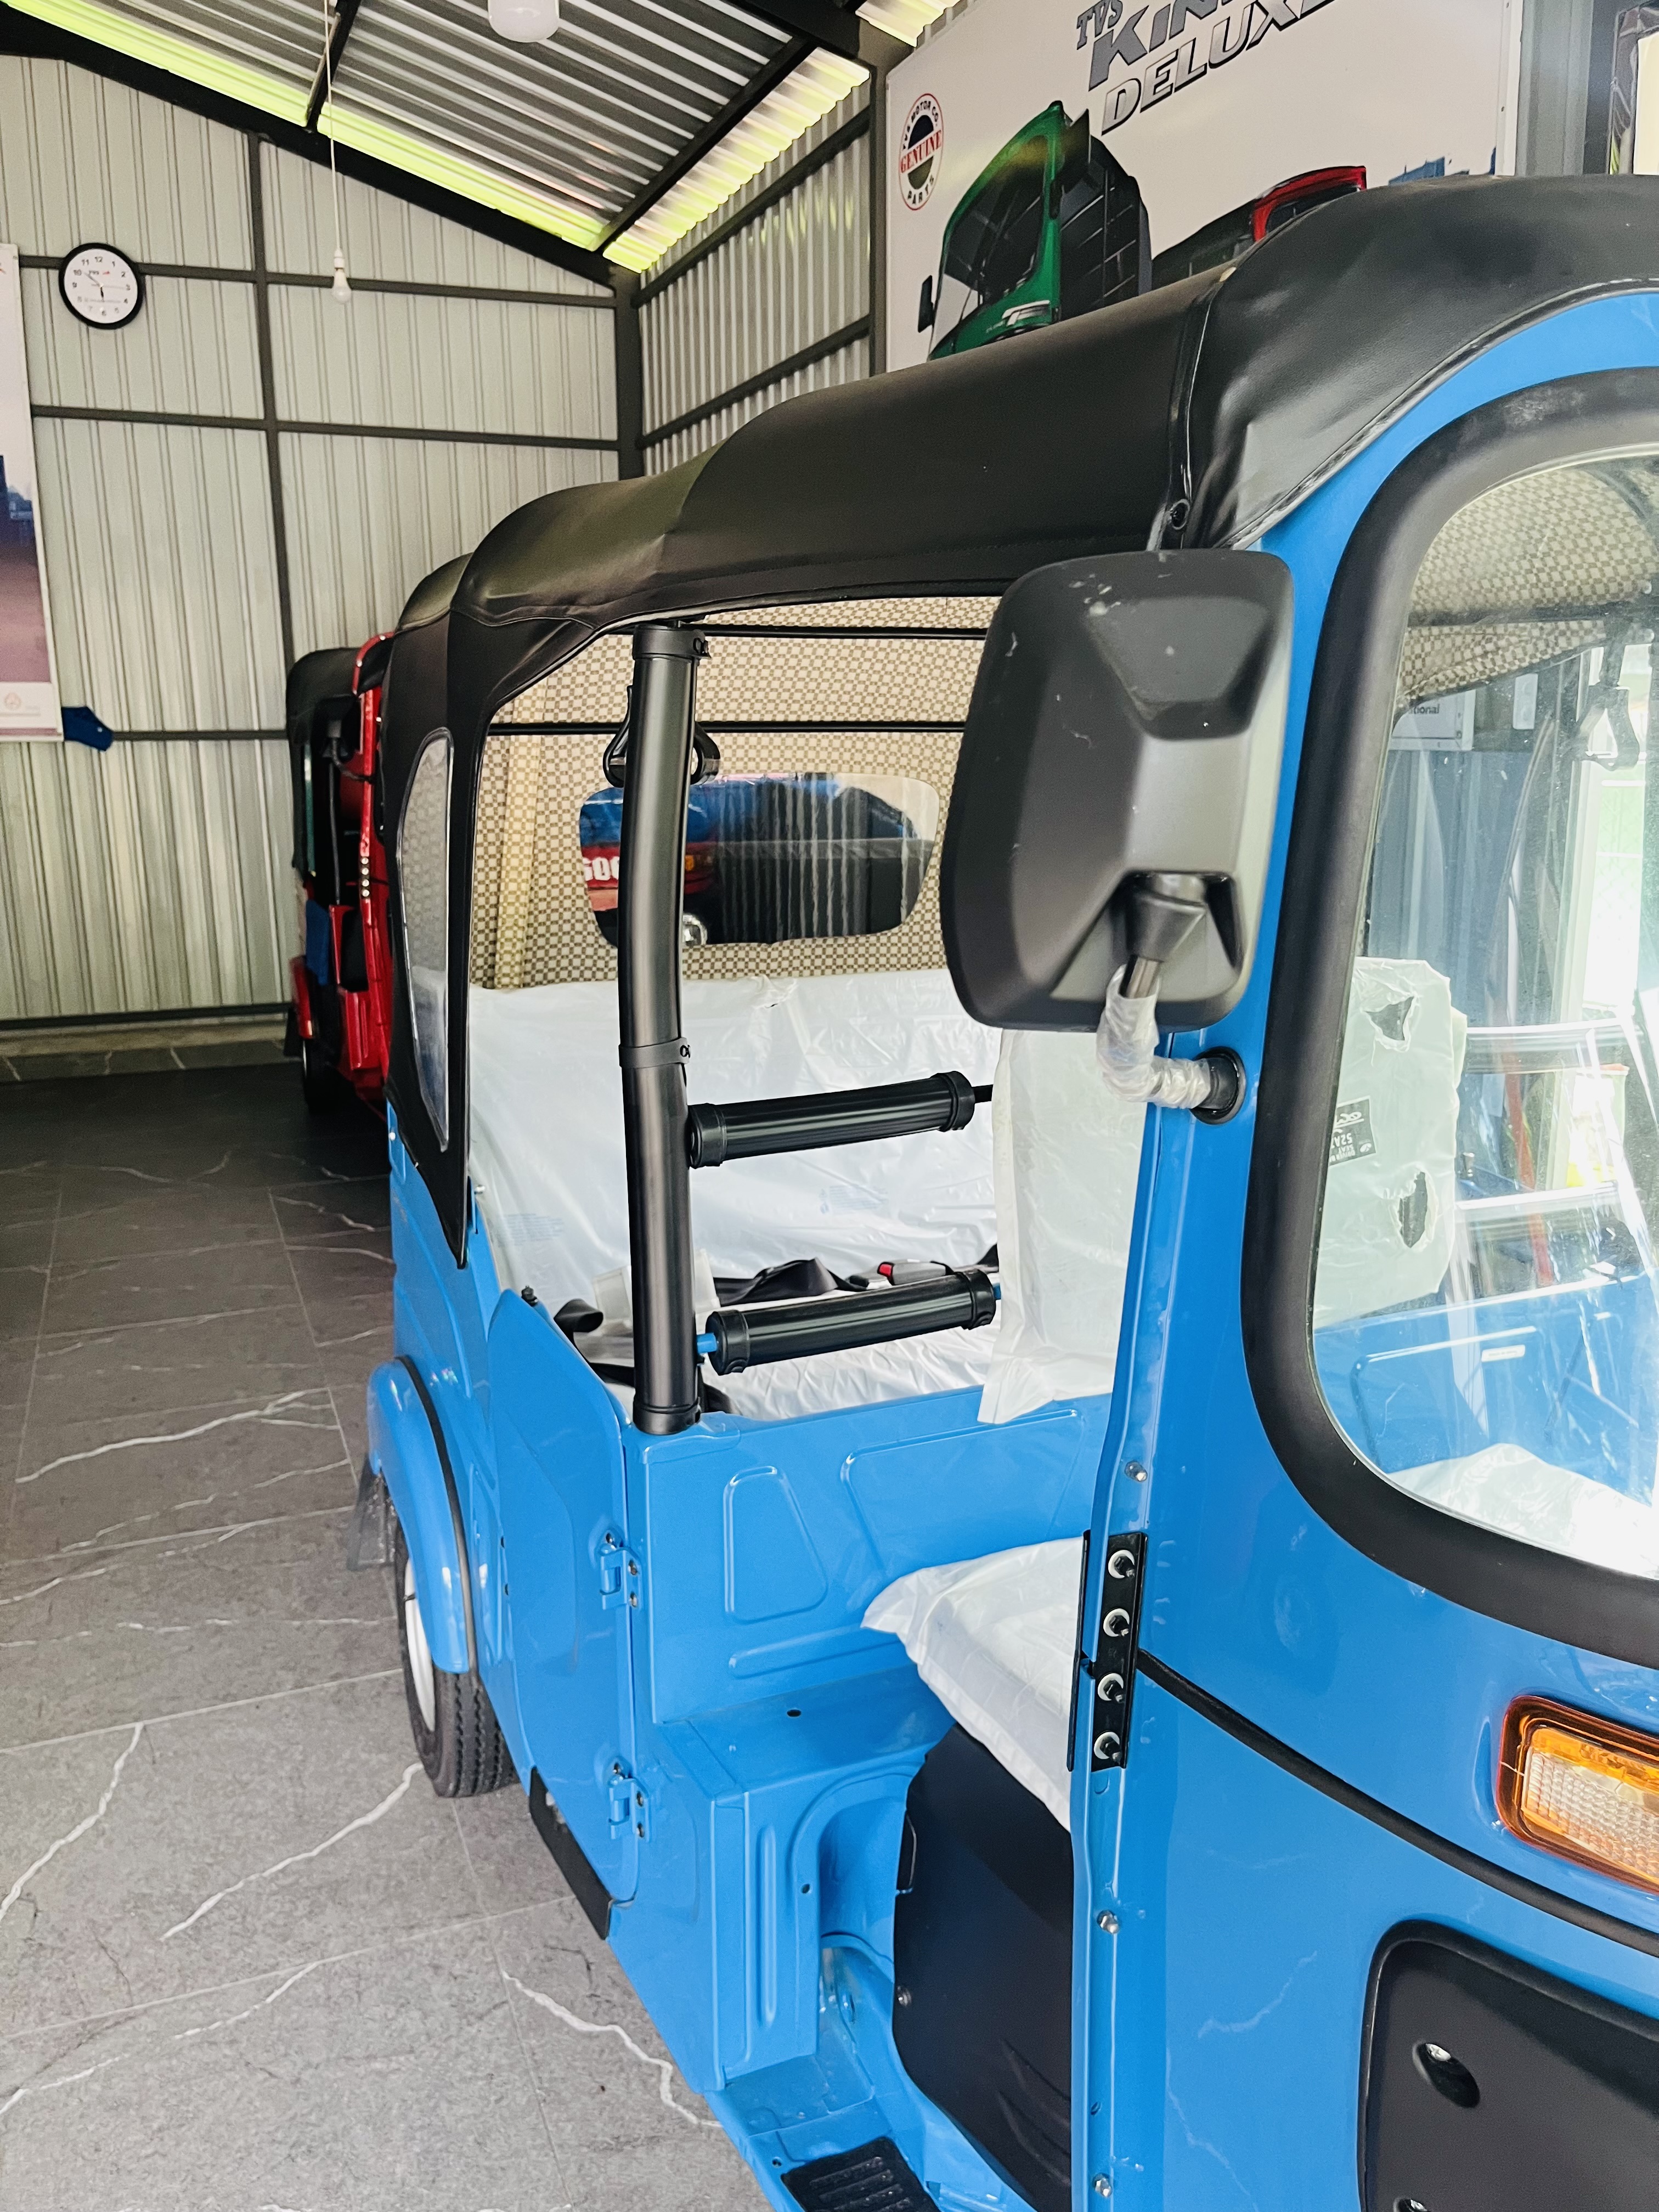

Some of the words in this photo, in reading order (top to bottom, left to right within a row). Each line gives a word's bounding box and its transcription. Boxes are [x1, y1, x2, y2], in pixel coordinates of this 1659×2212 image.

[1077, 0, 1123, 50] TVS
[1088, 0, 1234, 92] KIN
[1102, 0, 1336, 136] DELUX
[911, 100, 932, 123] MOTOR
[900, 129, 942, 173] GENUINE
[907, 174, 934, 205] PARTS
